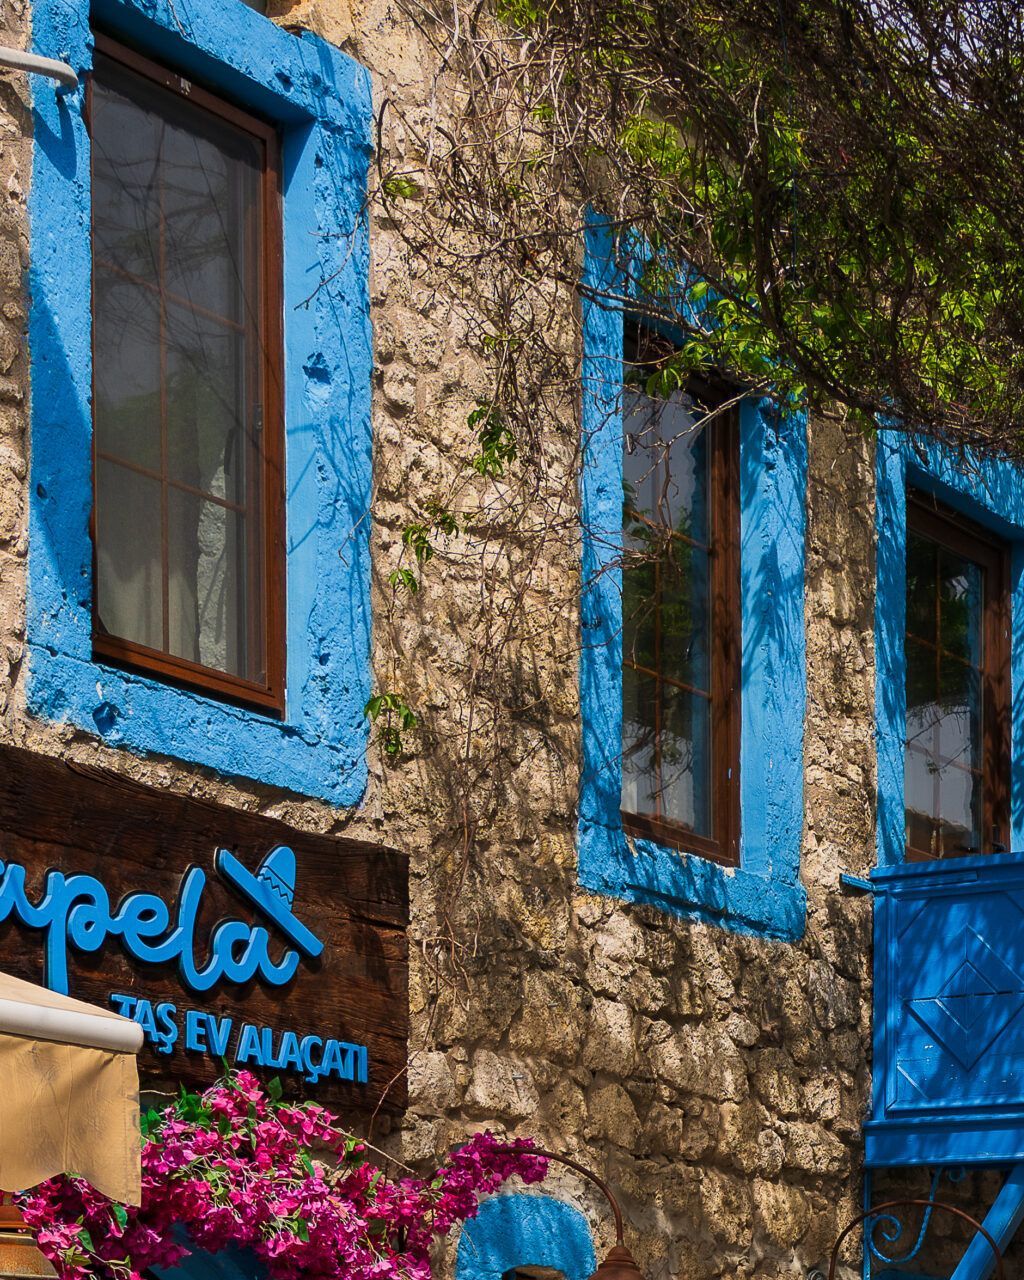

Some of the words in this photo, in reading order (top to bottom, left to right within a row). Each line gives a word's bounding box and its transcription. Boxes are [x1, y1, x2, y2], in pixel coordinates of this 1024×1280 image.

[110, 993, 178, 1054] TAŞ
[186, 1010, 233, 1056] EV
[236, 1023, 368, 1084] ALAÇATI
